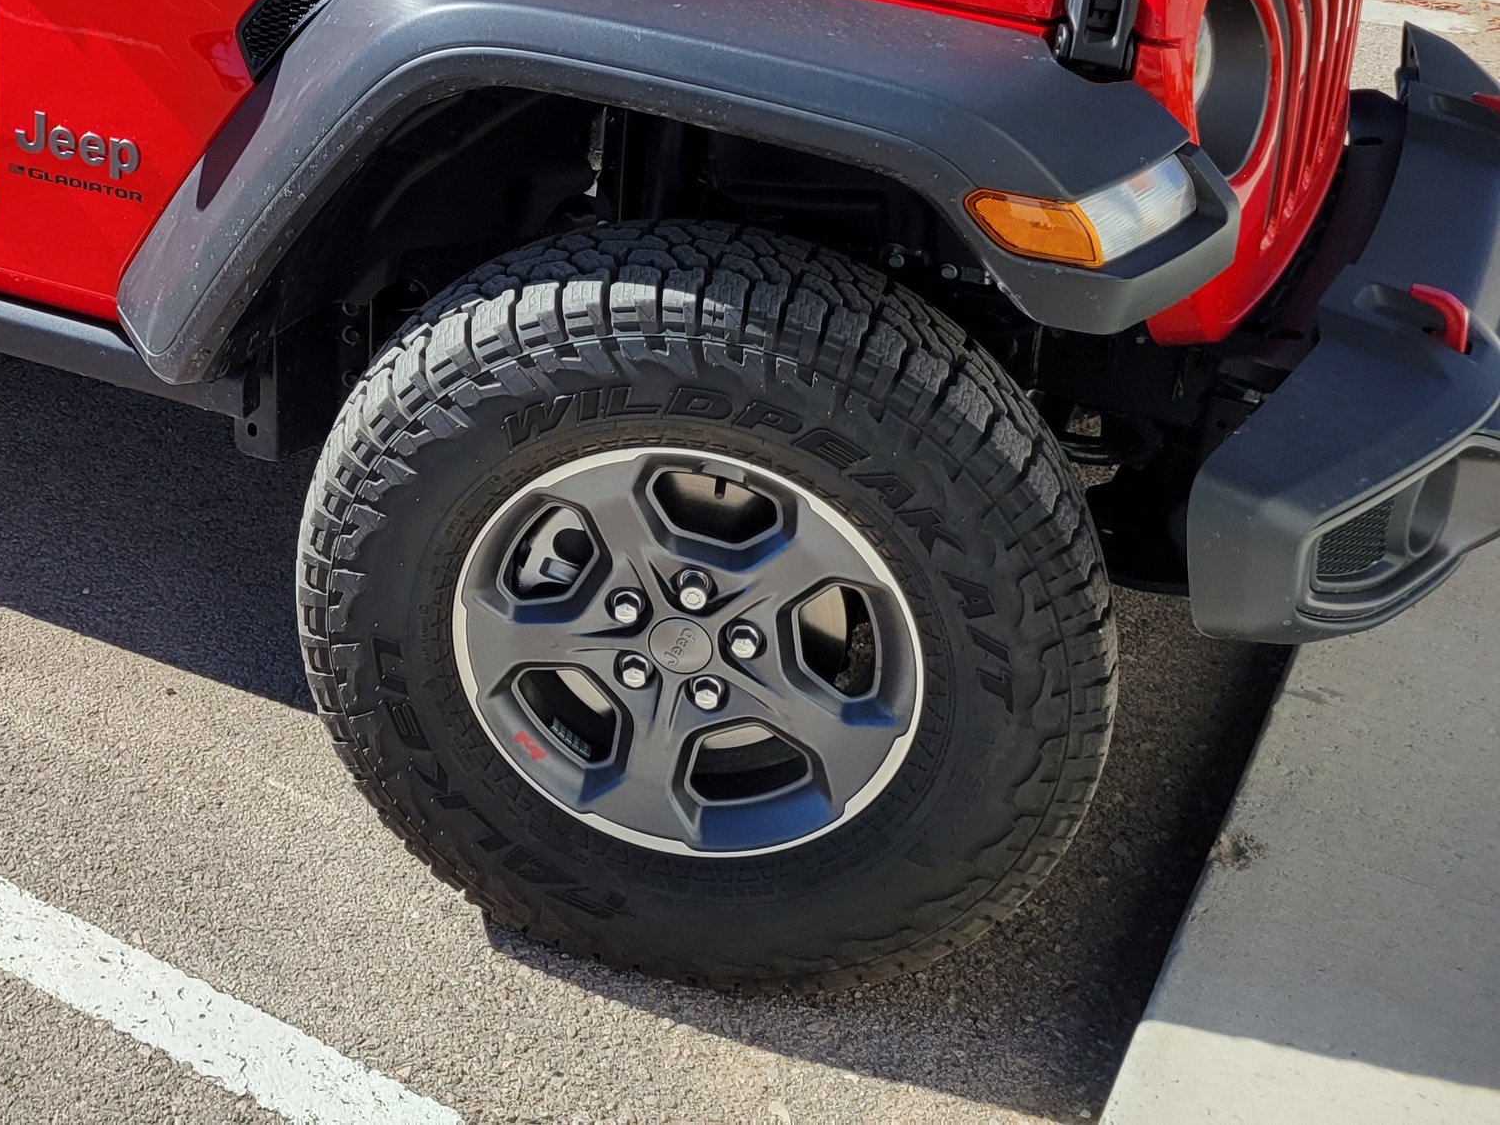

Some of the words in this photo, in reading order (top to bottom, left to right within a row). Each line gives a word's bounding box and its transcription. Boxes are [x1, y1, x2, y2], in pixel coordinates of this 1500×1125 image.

[15, 110, 140, 180] Jeep
[27, 167, 143, 203] GLADIATOR
[502, 386, 967, 559] WILDPEAK
[663, 627, 695, 666] Jeep
[371, 635, 637, 920] FALKEN
